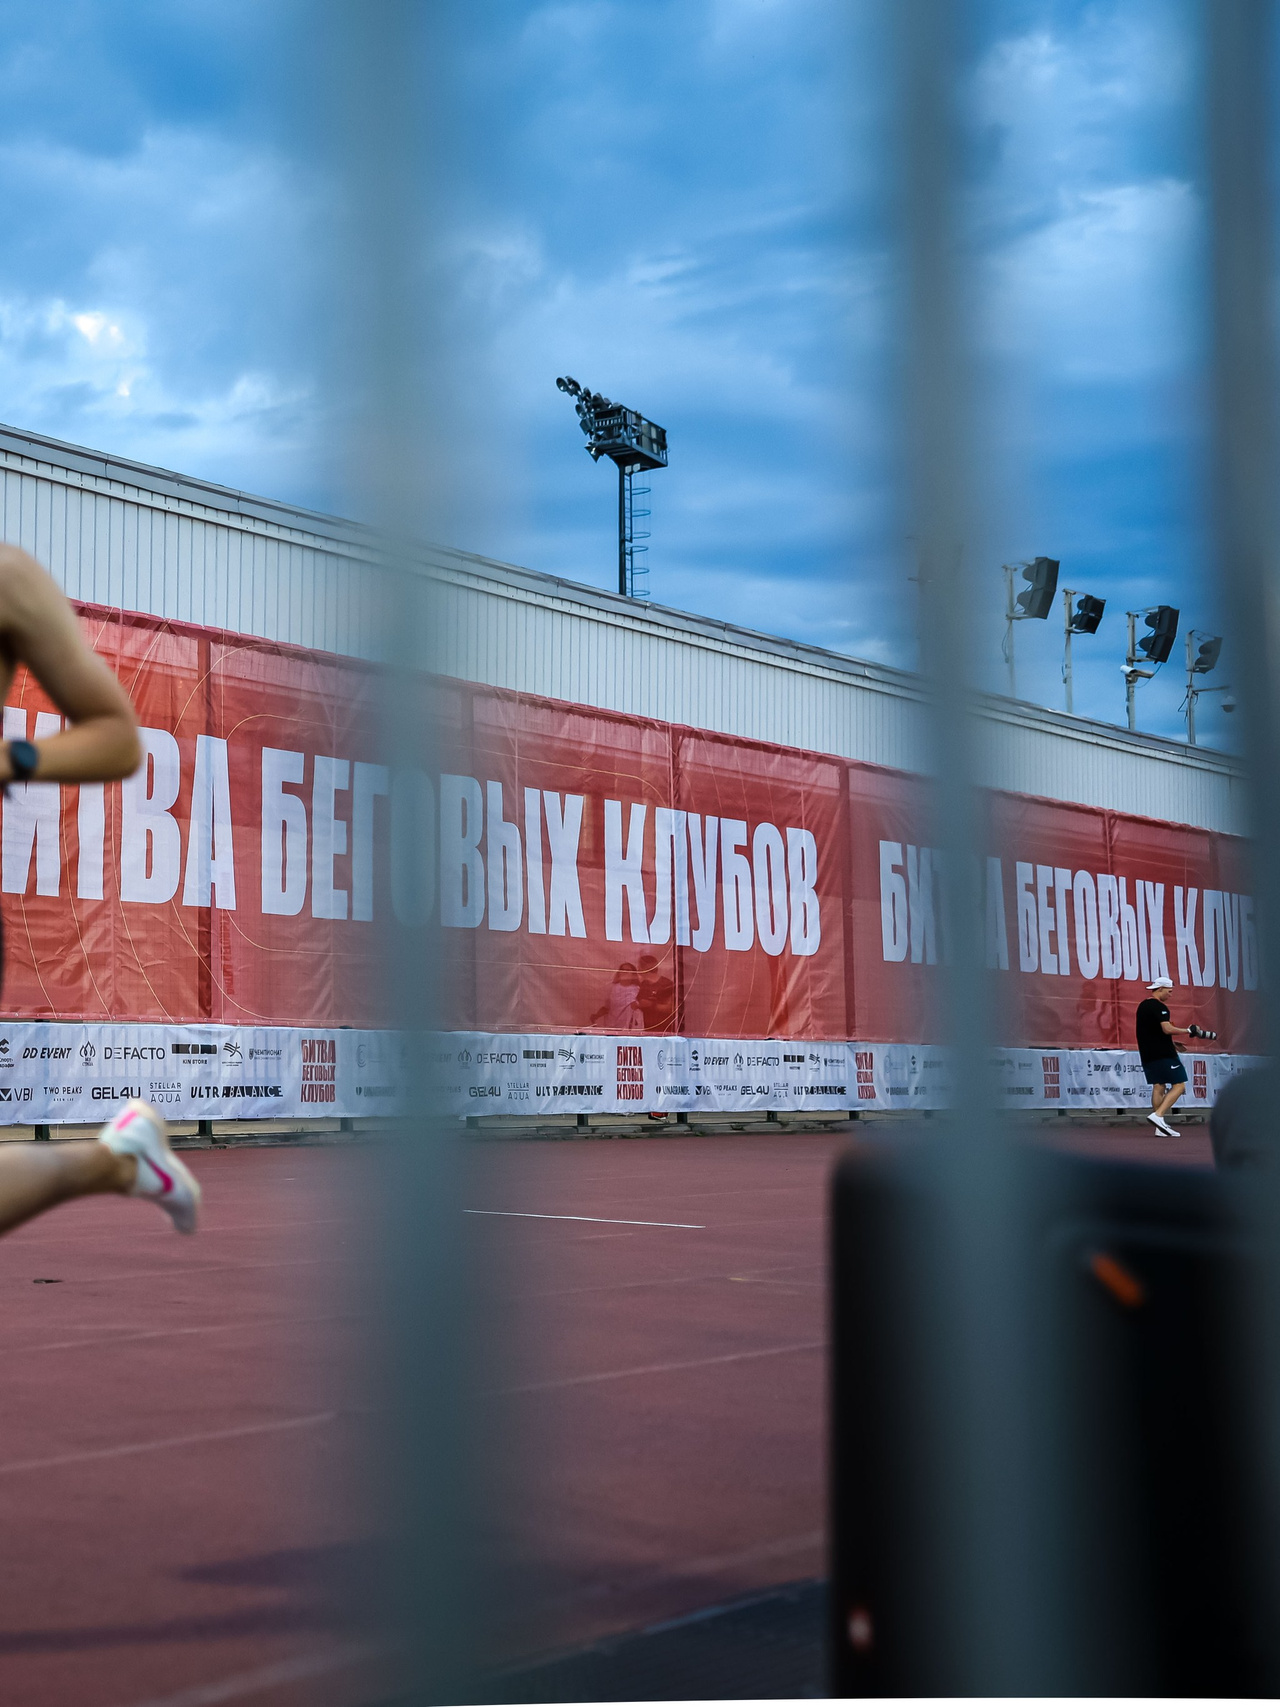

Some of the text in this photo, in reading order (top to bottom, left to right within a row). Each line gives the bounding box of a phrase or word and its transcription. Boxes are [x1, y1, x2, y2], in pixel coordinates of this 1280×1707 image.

[262, 747, 587, 938] БЕГОВЫХ
[604, 799, 821, 956] КЛУБОВ
[879, 839, 1261, 992] БИА БЕГОВЫХ КЛУБ
[22, 1047, 72, 1059] DD EVENT
[104, 1047, 166, 1060] DEFACTO
[301, 1040, 336, 1063] БИТВА
[616, 1046, 643, 1066] БИТВА
[476, 1053, 518, 1064] DEFACTO
[302, 1065, 336, 1081] БЕГОВЫХ
[14, 1088, 33, 1101] VBI
[43, 1086, 83, 1095] TWO PEAKS
[91, 1086, 141, 1100] GEL4U
[190, 1085, 284, 1098] ULTRABALANCE
[301, 1084, 336, 1102] КЛУБОВ
[469, 1086, 501, 1098] GEL4U
[507, 1092, 530, 1101] AQUA
[616, 1084, 644, 1100] КЛУБОВ
[740, 1085, 770, 1096] GEL4U
[150, 1093, 182, 1103] AQUA
